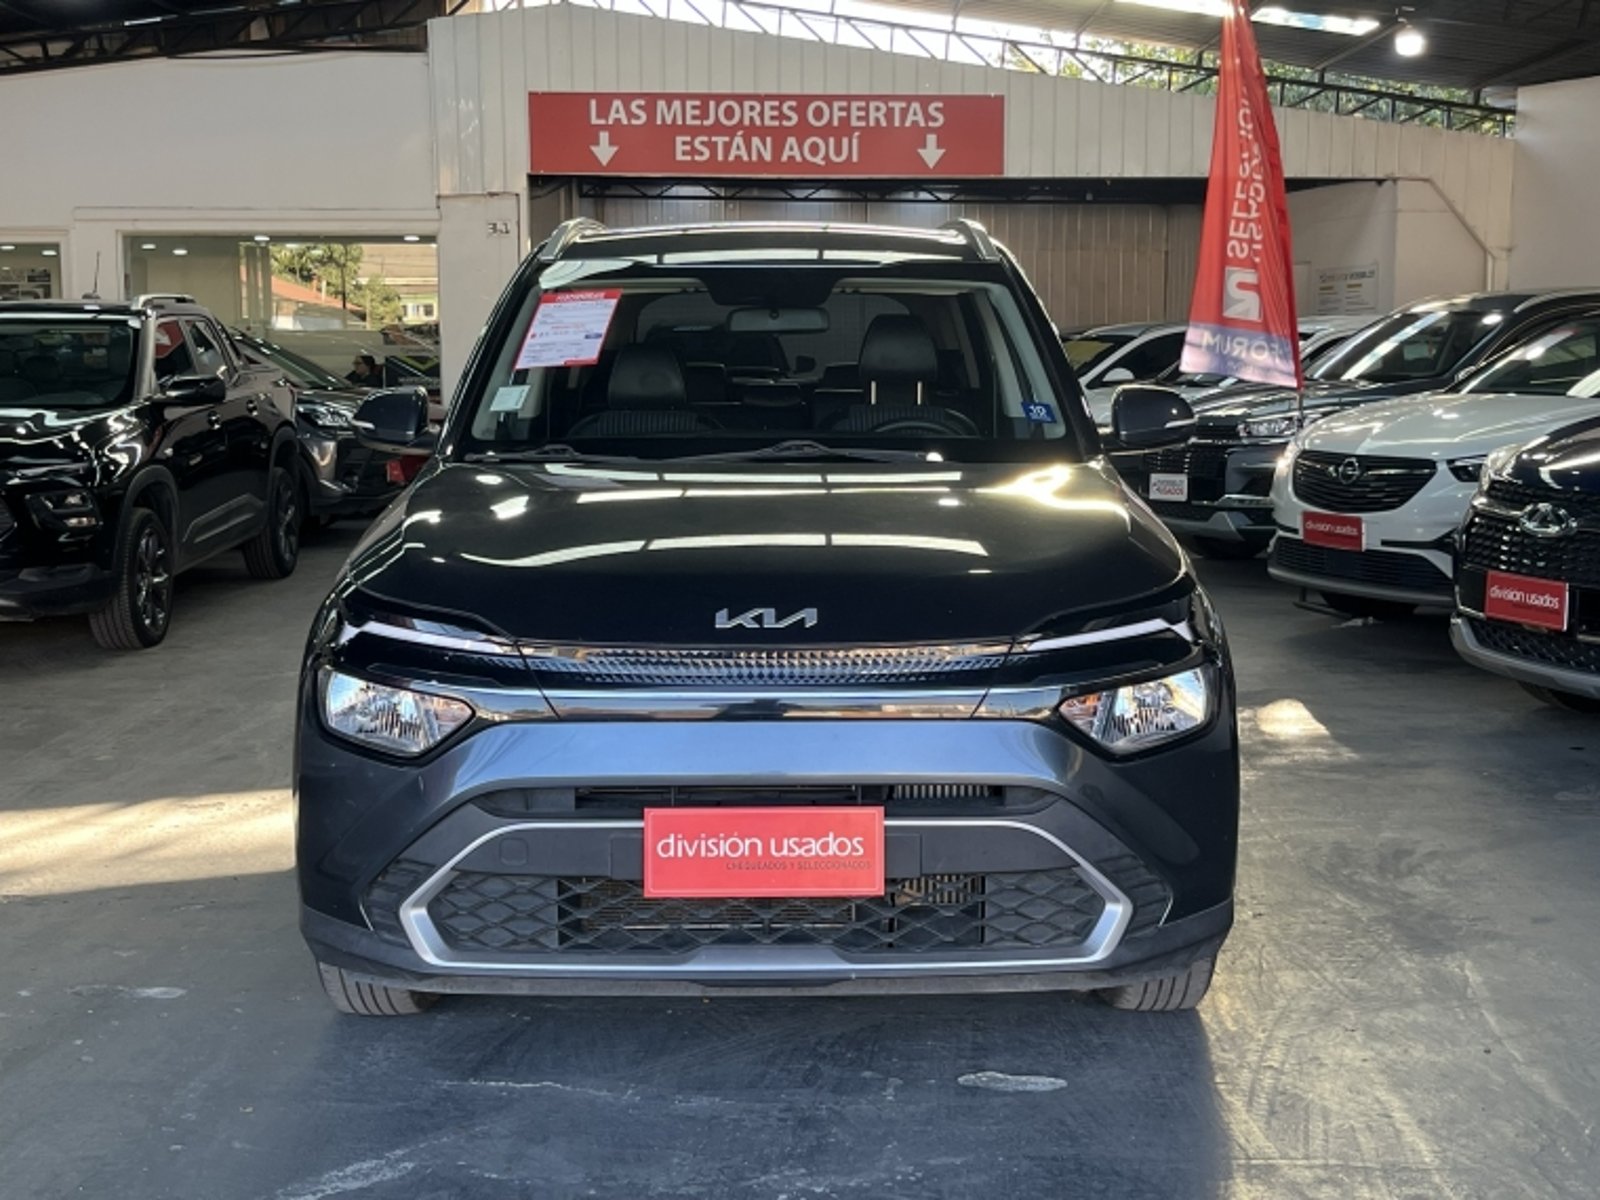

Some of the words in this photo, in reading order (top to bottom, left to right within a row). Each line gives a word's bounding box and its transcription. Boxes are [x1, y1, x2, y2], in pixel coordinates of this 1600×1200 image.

[588, 98, 648, 126] LAS
[655, 99, 798, 127] MEJORES
[805, 100, 945, 128] OFERTAS
[674, 130, 773, 162] ESTÁN
[780, 131, 860, 165] AQUÍ
[1526, 592, 1560, 610] usados
[715, 607, 818, 629] KIA
[656, 831, 762, 858] división
[769, 831, 865, 857] usados
[726, 860, 787, 871] CHEQUEADOS
[789, 860, 795, 870] Y
[797, 860, 872, 870] SELECCIONADOS
